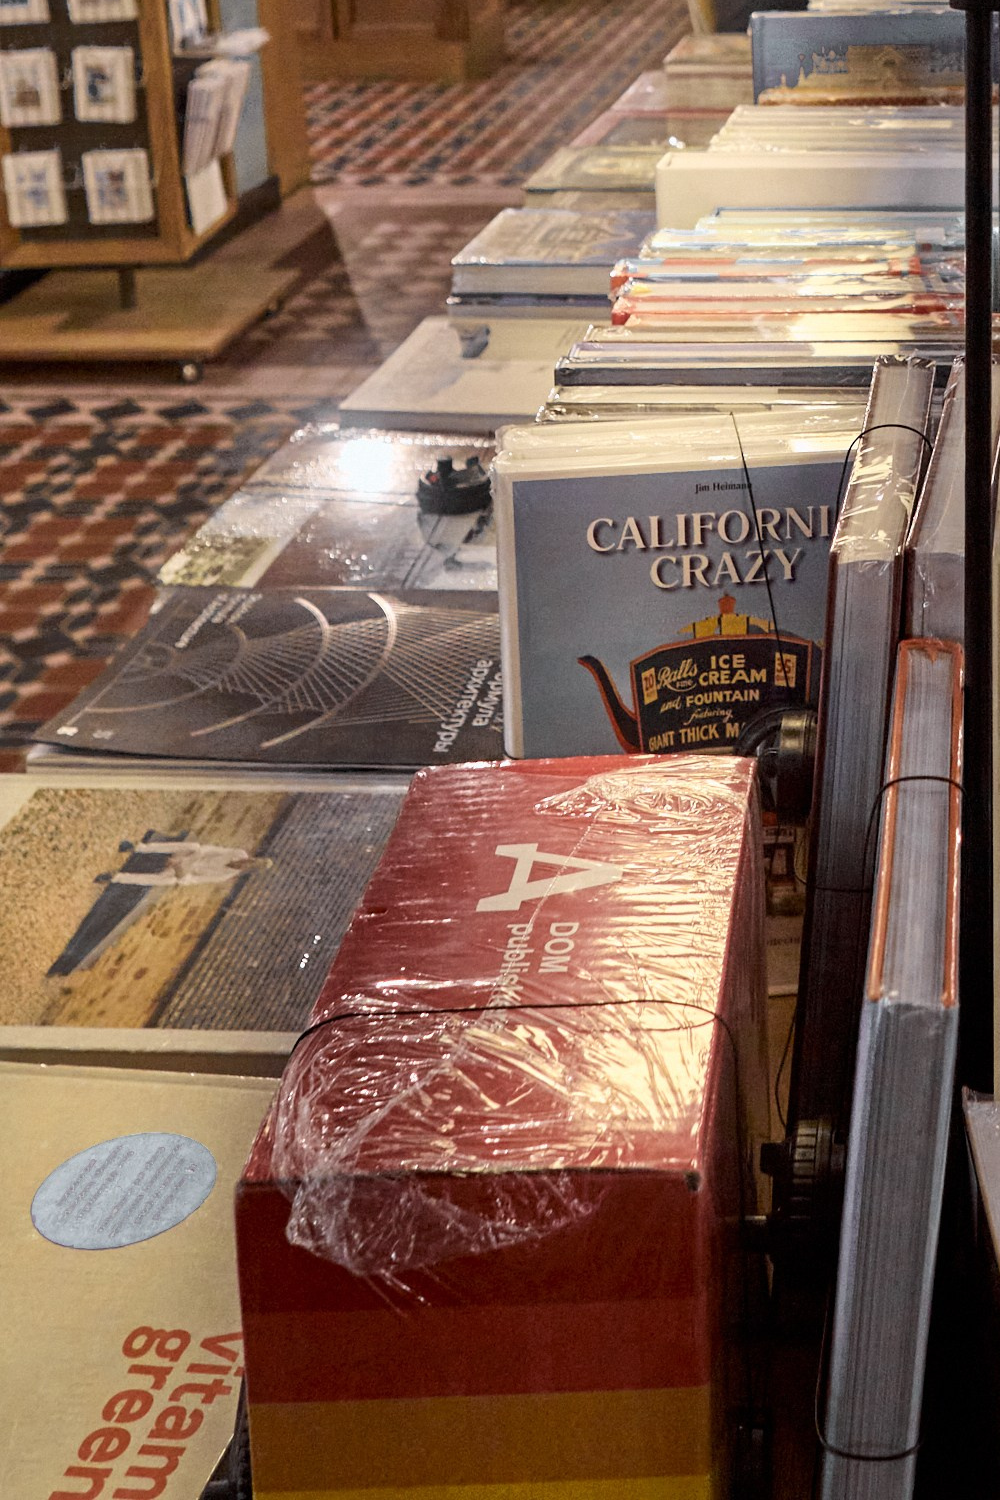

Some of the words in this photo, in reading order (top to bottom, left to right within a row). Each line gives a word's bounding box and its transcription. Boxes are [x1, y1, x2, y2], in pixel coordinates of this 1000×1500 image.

[695, 483, 710, 494] Jim
[651, 547, 802, 589] CRAZY
[710, 654, 746, 670] ICE
[699, 668, 767, 687] CREAM
[433, 660, 493, 752] архитектуры
[660, 694, 682, 713] and
[686, 689, 760, 708] FOUNTAIN
[683, 708, 733, 726] featuring
[649, 731, 675, 751] GIANT
[679, 723, 720, 744] THICK
[537, 922, 580, 973] DOM
